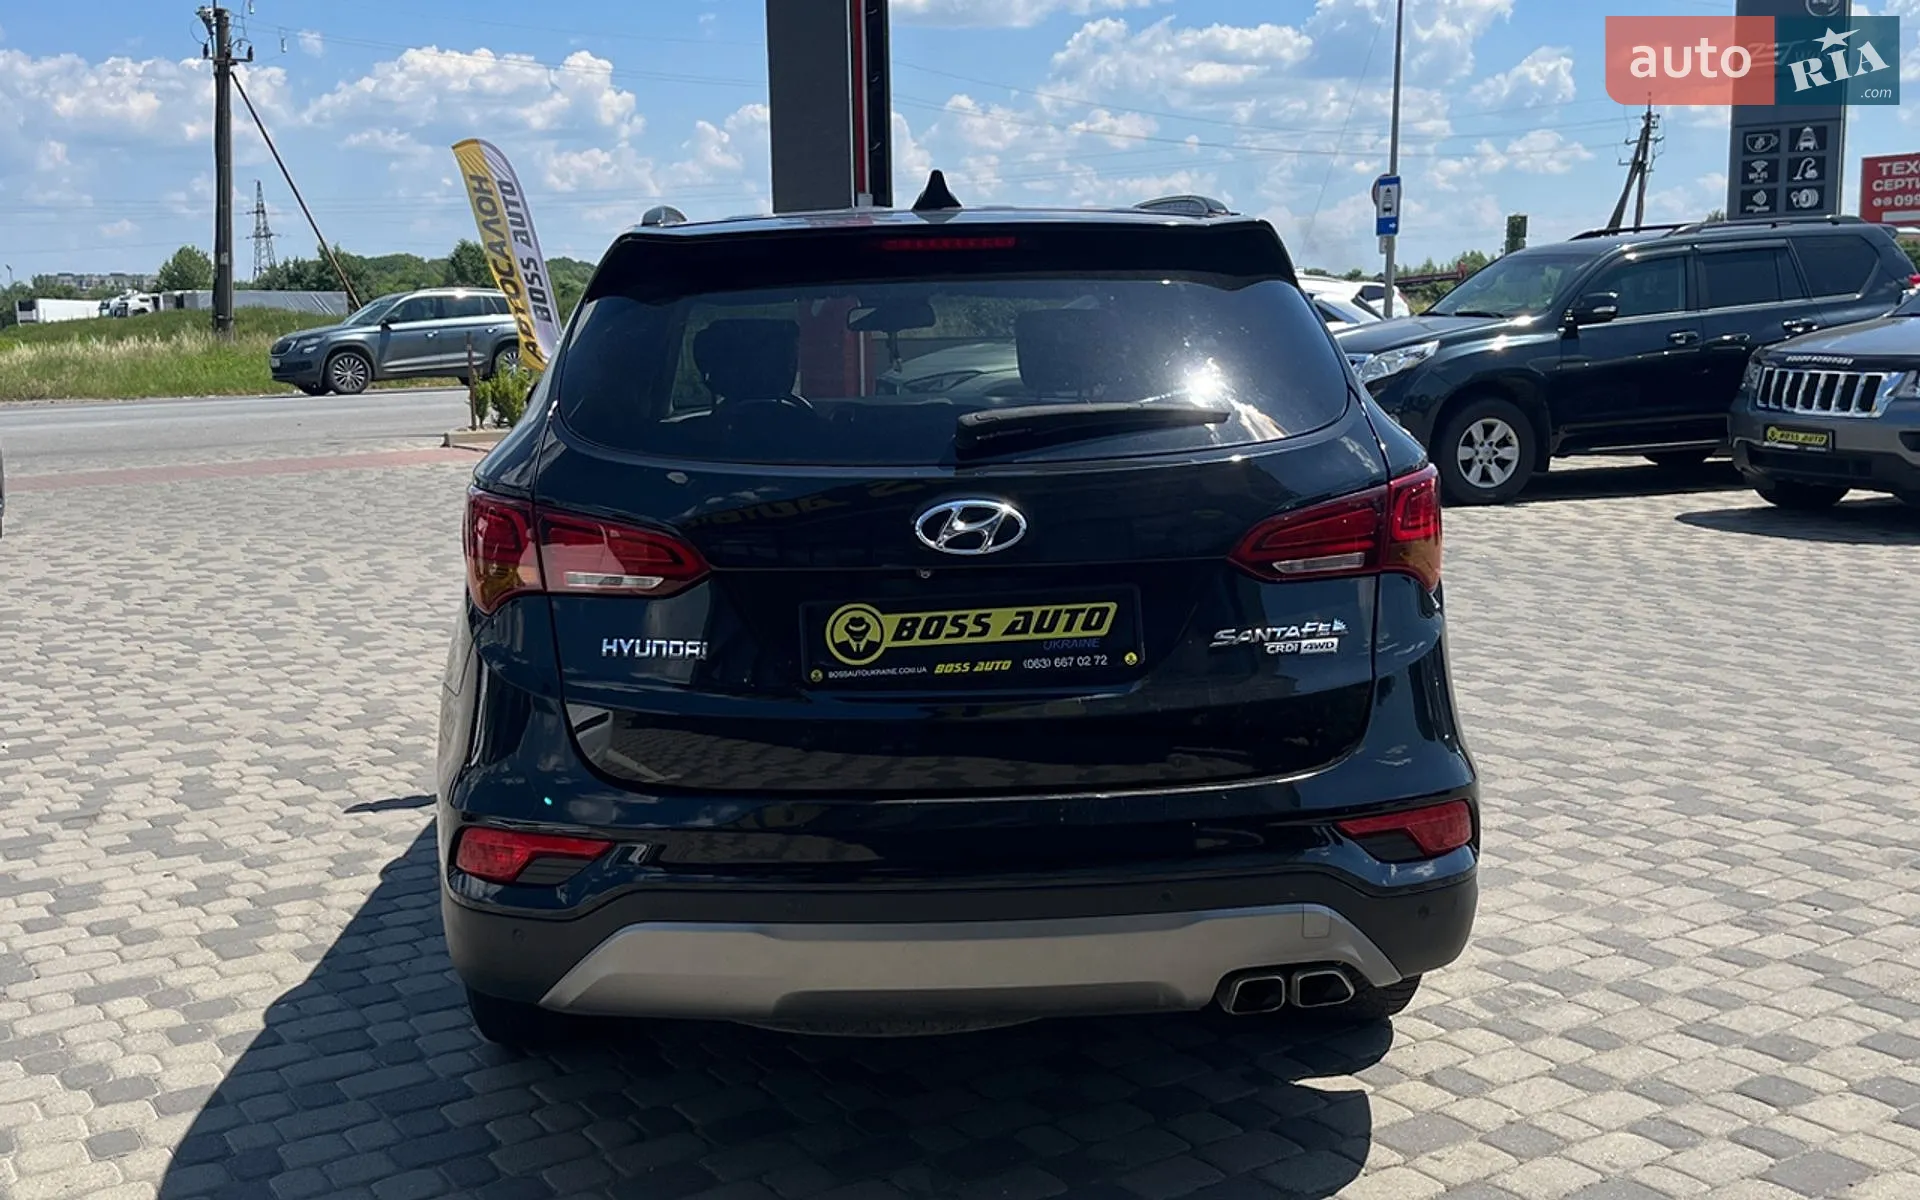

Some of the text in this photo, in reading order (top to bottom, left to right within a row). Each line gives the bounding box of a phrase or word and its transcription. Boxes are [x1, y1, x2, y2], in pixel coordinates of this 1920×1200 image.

[1878, 161, 1920, 176] ТЕХ
[520, 257, 553, 323] BOSS
[891, 607, 1111, 642] BOSS AUTO
[602, 638, 708, 659] HYUNDAI
[1043, 638, 1101, 650] UKRAINE
[934, 660, 1012, 674] BOSS AUTO
[1053, 656, 1075, 668] 667
[1077, 655, 1092, 667] 02
[1093, 654, 1108, 666] 72
